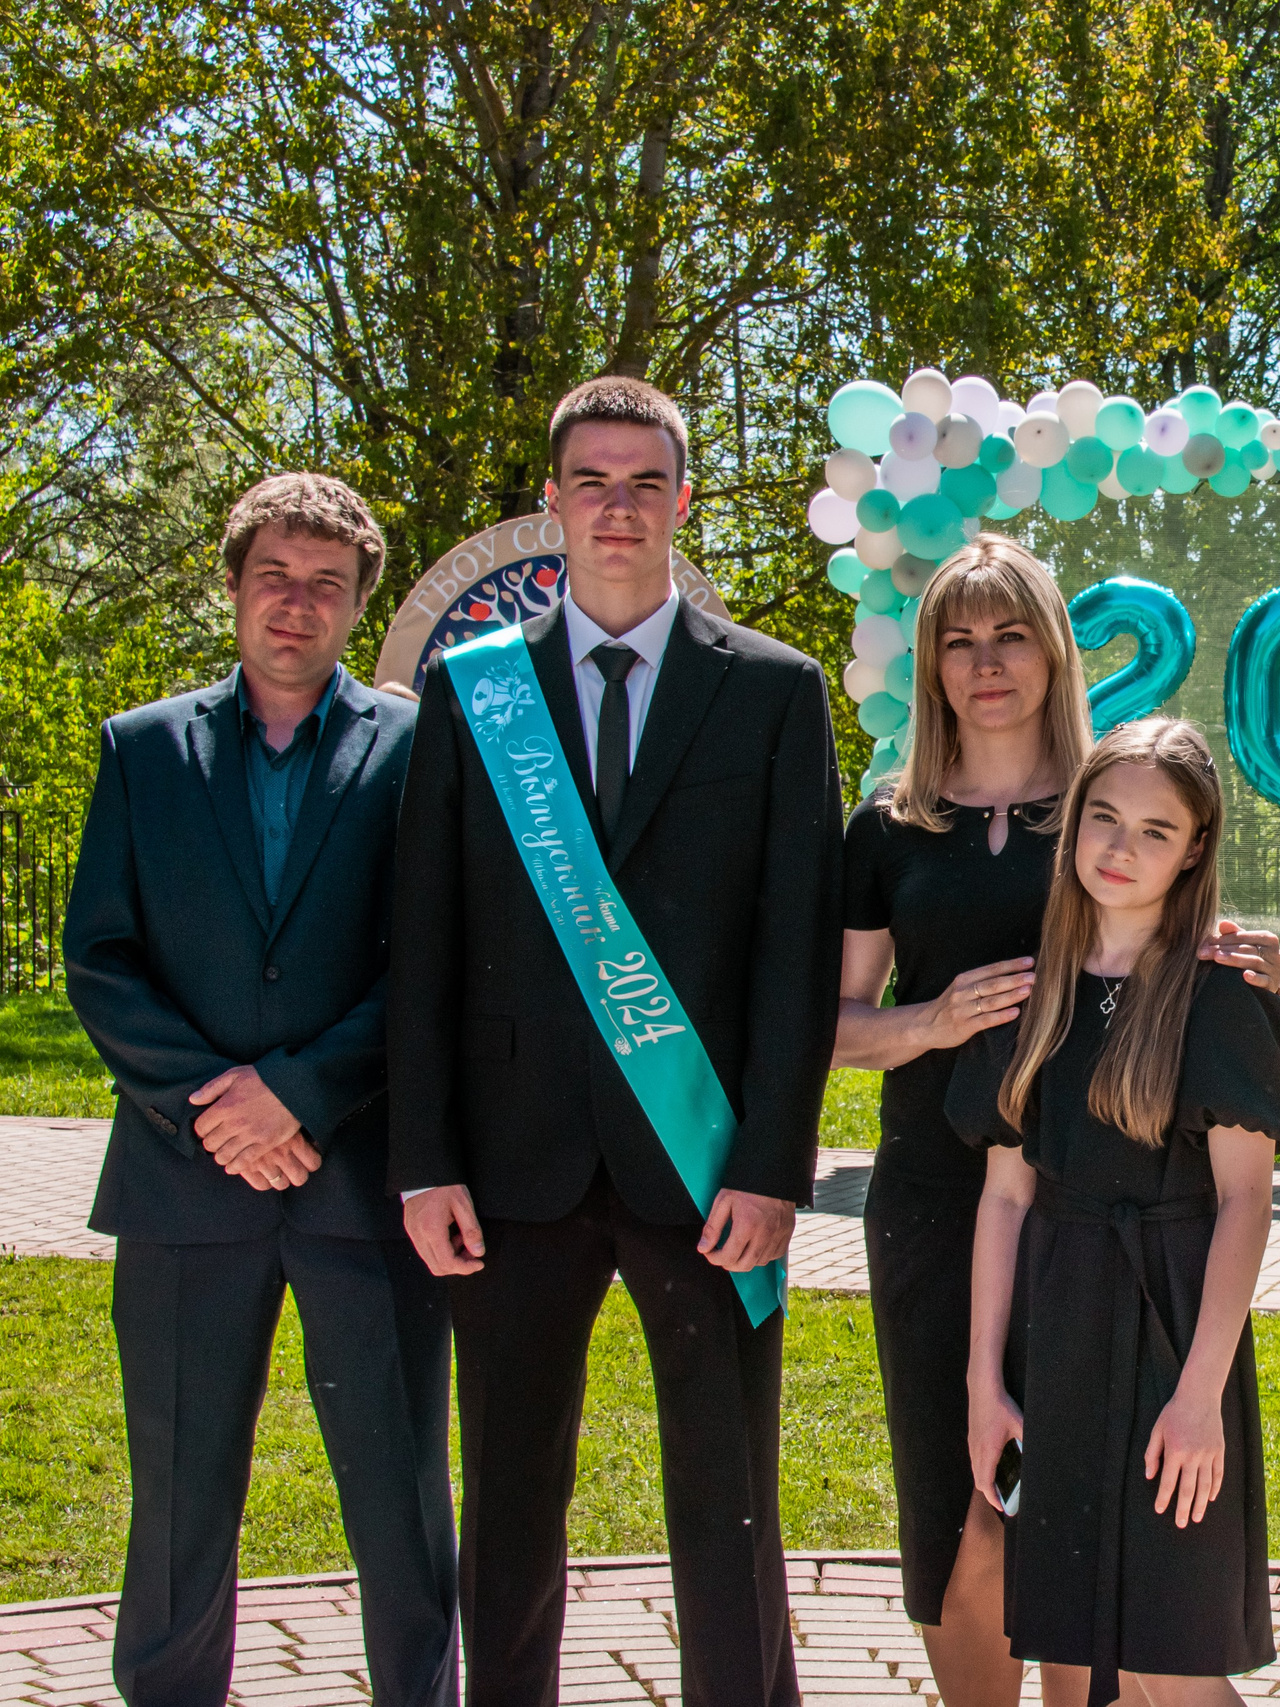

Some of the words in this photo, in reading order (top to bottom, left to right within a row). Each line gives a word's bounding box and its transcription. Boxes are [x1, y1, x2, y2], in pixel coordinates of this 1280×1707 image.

[411, 532, 497, 622] ГБОУ
[512, 519, 565, 554] СО
[671, 559, 710, 609] 50
[505, 735, 606, 945] Выпускник
[594, 951, 687, 1048] 2024
